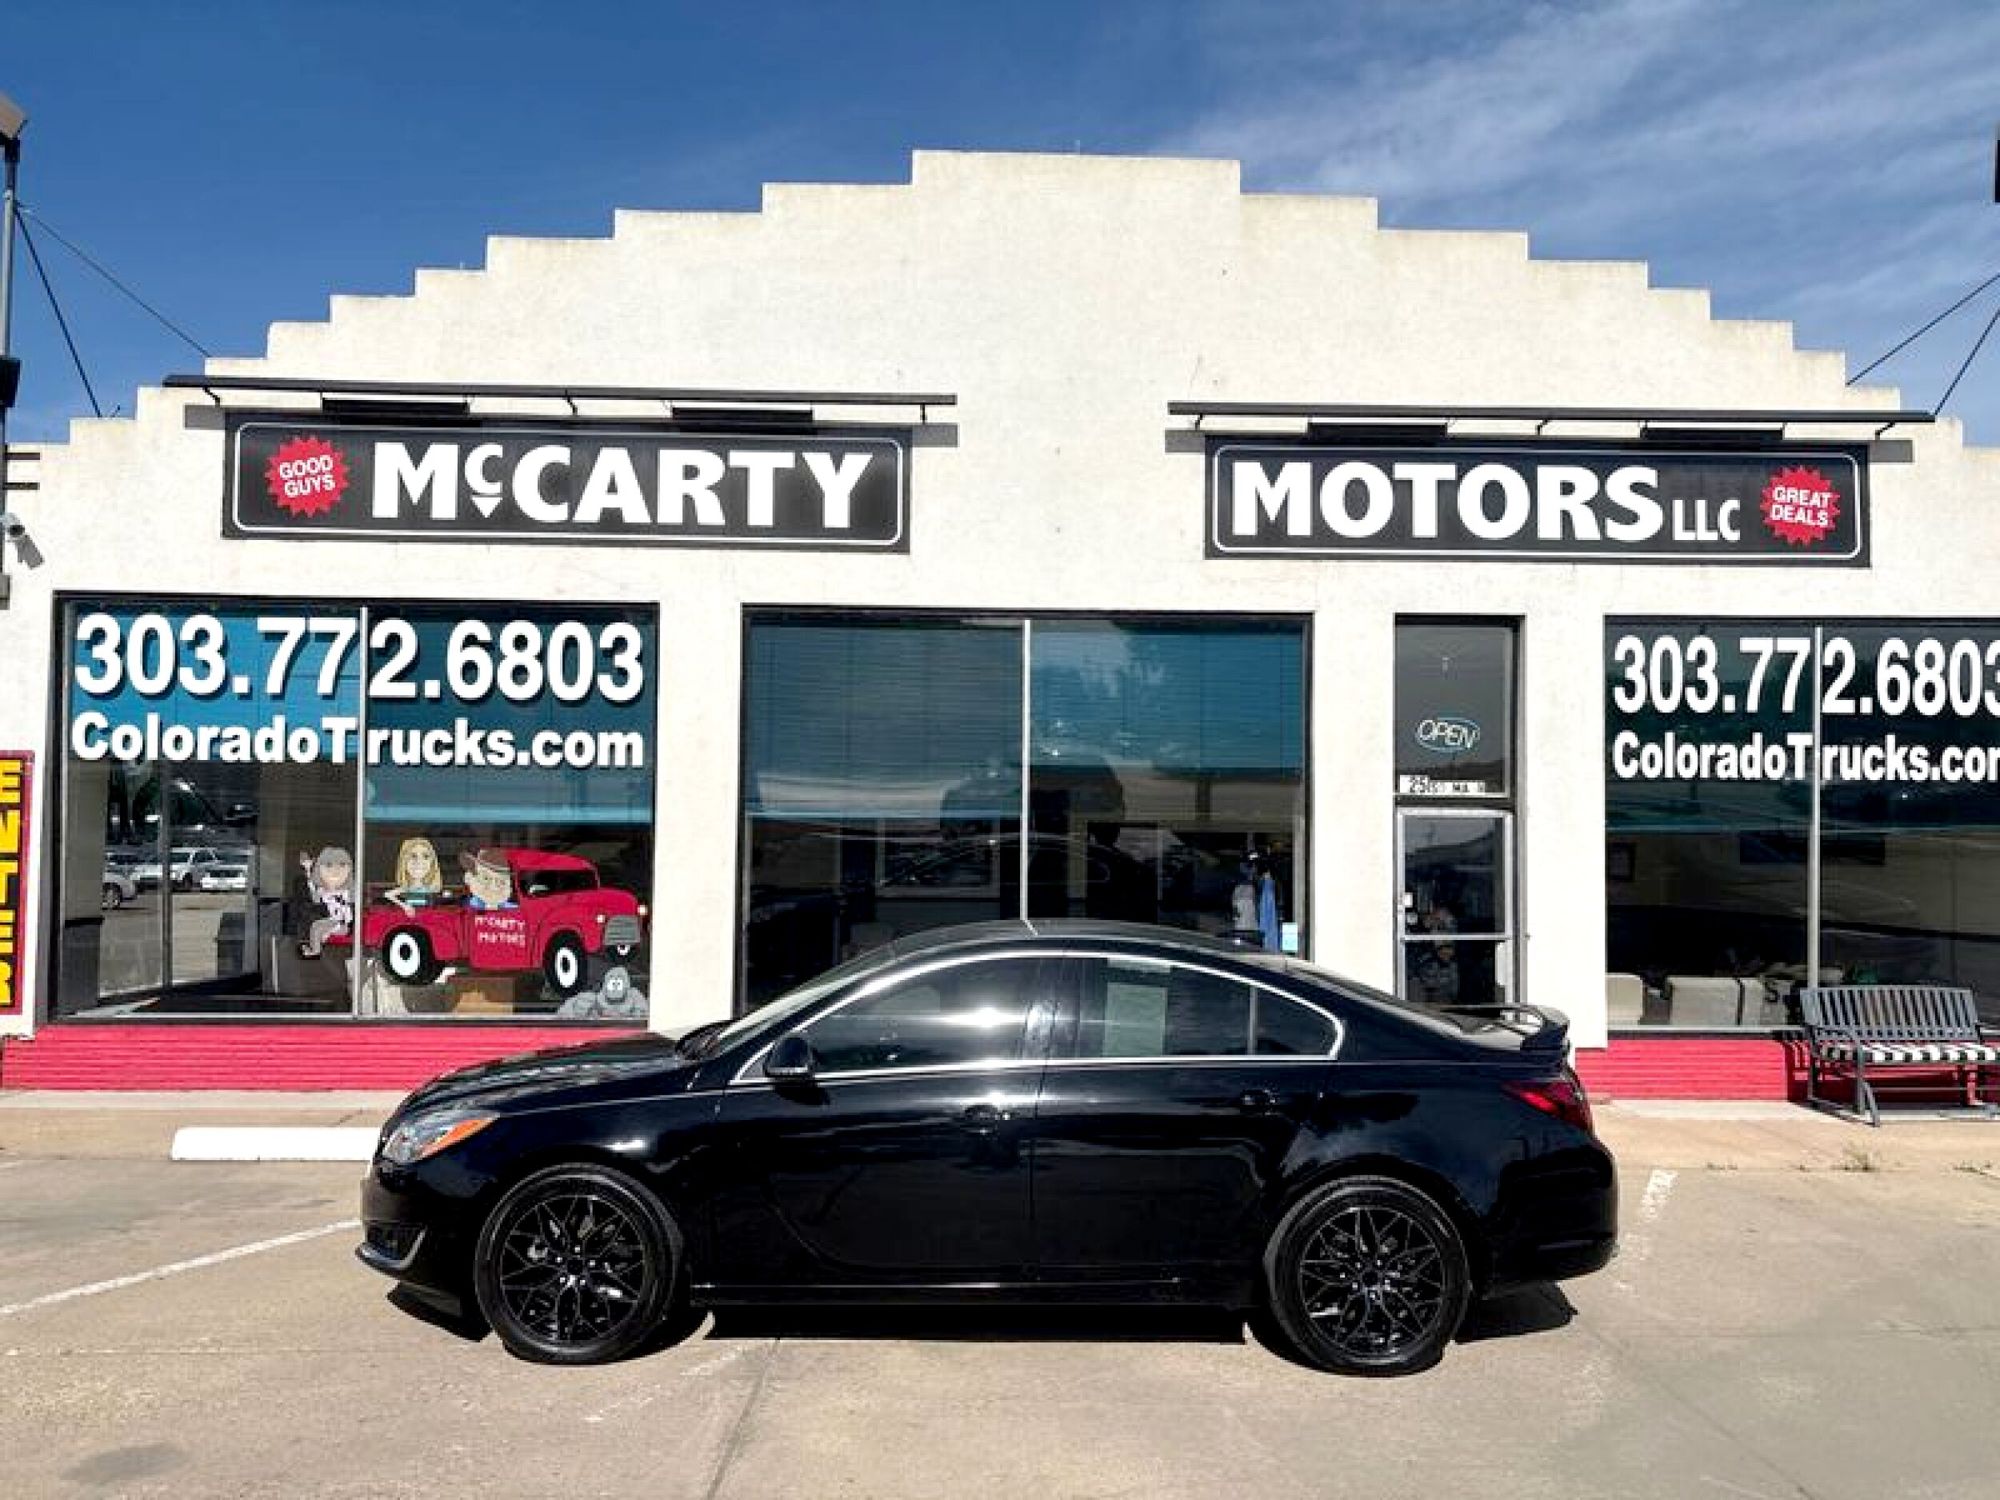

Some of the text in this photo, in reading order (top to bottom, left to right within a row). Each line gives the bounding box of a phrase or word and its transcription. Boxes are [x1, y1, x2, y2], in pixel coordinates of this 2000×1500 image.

[279, 455, 334, 480] GOOD
[284, 474, 336, 498] GUYS
[371, 441, 874, 529] McCARTY
[1773, 485, 1832, 509] GREAT
[1232, 461, 1741, 542] MOTORS LLC
[1771, 504, 1829, 528] DEALS
[74, 612, 645, 703] 303.772.6803
[71, 711, 645, 768] ColoradoTrucks.com
[1418, 719, 1481, 750] OPEN
